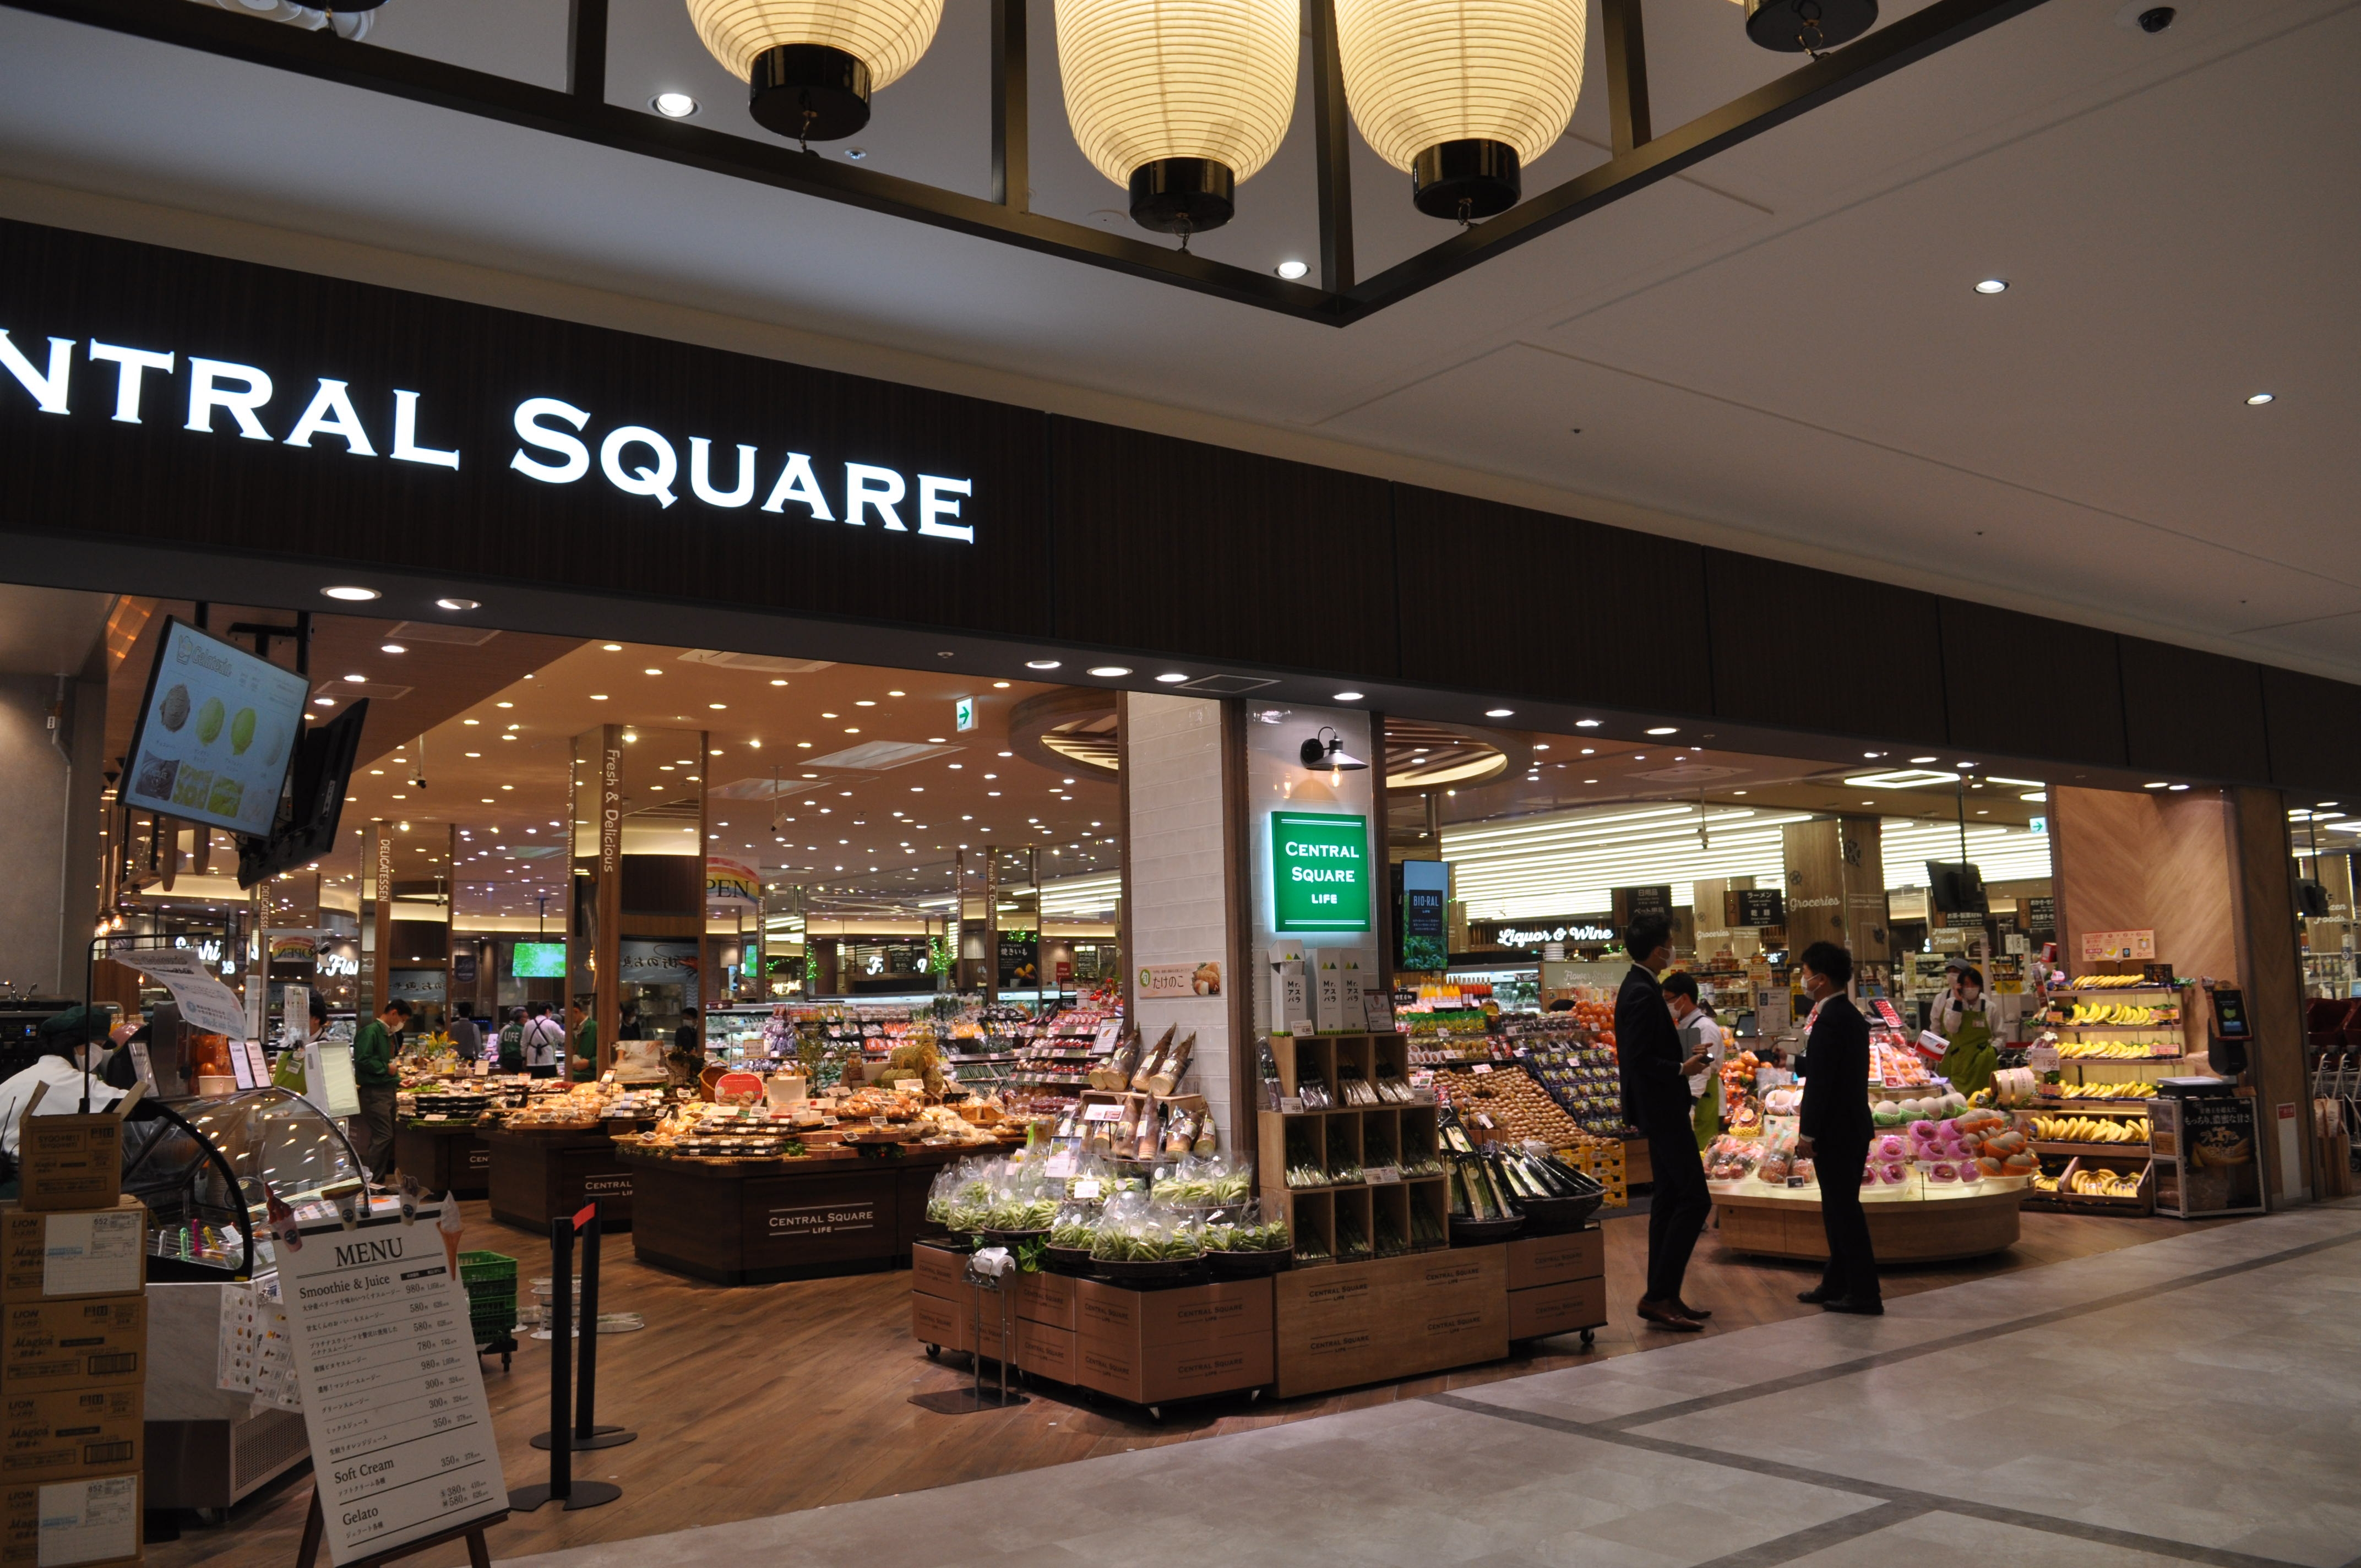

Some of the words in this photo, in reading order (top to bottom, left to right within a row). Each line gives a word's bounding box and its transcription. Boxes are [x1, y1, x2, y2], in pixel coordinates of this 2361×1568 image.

[0, 329, 460, 471] NTRAL
[510, 398, 975, 545] SQUARE
[607, 749, 620, 786] Fresh
[606, 792, 619, 803] &
[604, 810, 618, 873] Delicious
[1285, 841, 1360, 858] CENTRAL
[378, 839, 390, 902] DELICATESSEN
[1292, 866, 1355, 883] SQUARE
[1312, 894, 1338, 904] LIFE
[1789, 895, 1841, 912] Groceries
[260, 885, 270, 932] DELICATESSE
[1497, 928, 1552, 948] Liquor
[1553, 927, 1567, 941] &
[1569, 925, 1614, 941] Wine
[1696, 929, 1730, 940] Groceries
[1000, 948, 1028, 958] 焼きいも
[1153, 976, 1184, 989] たけのこ
[504, 1031, 520, 1043] LIFE
[585, 1180, 632, 1189] CENTRAL
[13, 1219, 38, 1228] LION
[769, 1216, 824, 1227] CENTRAL
[827, 1211, 874, 1222] SQUARE
[13, 1244, 45, 1259] Magic
[335, 1237, 404, 1267] MENU
[1426, 1271, 1454, 1281] CENTRAL
[1455, 1268, 1479, 1277] SQUARE
[299, 1279, 350, 1299] Smoothie
[353, 1278, 363, 1289] &
[365, 1275, 390, 1291] Juice
[1309, 1287, 1340, 1298] CENTRAL
[1342, 1283, 1368, 1293] SQUARE
[13, 1309, 40, 1319] LION
[1085, 1303, 1107, 1315] CENTRAL
[1108, 1308, 1129, 1320] SQUARE
[1178, 1308, 1212, 1317] CENTRAL
[1214, 1304, 1243, 1313] SQUARE
[1427, 1321, 1456, 1331] CENTRAL
[1457, 1316, 1481, 1326] SQUARE
[13, 1335, 54, 1349] Magica
[1310, 1340, 1341, 1349] CENTRAL
[1343, 1335, 1369, 1345] SQUARE
[1085, 1356, 1108, 1369] CENTRAL
[1109, 1363, 1129, 1375] SQUARE
[1178, 1364, 1212, 1374] CENTRAL
[1214, 1359, 1243, 1368] SQUARE
[9, 1400, 35, 1410] LION
[9, 1427, 49, 1439] Magica
[334, 1468, 357, 1484] Soft
[360, 1459, 395, 1476] Cream
[9, 1490, 35, 1501] LION
[342, 1507, 379, 1526] Gelato
